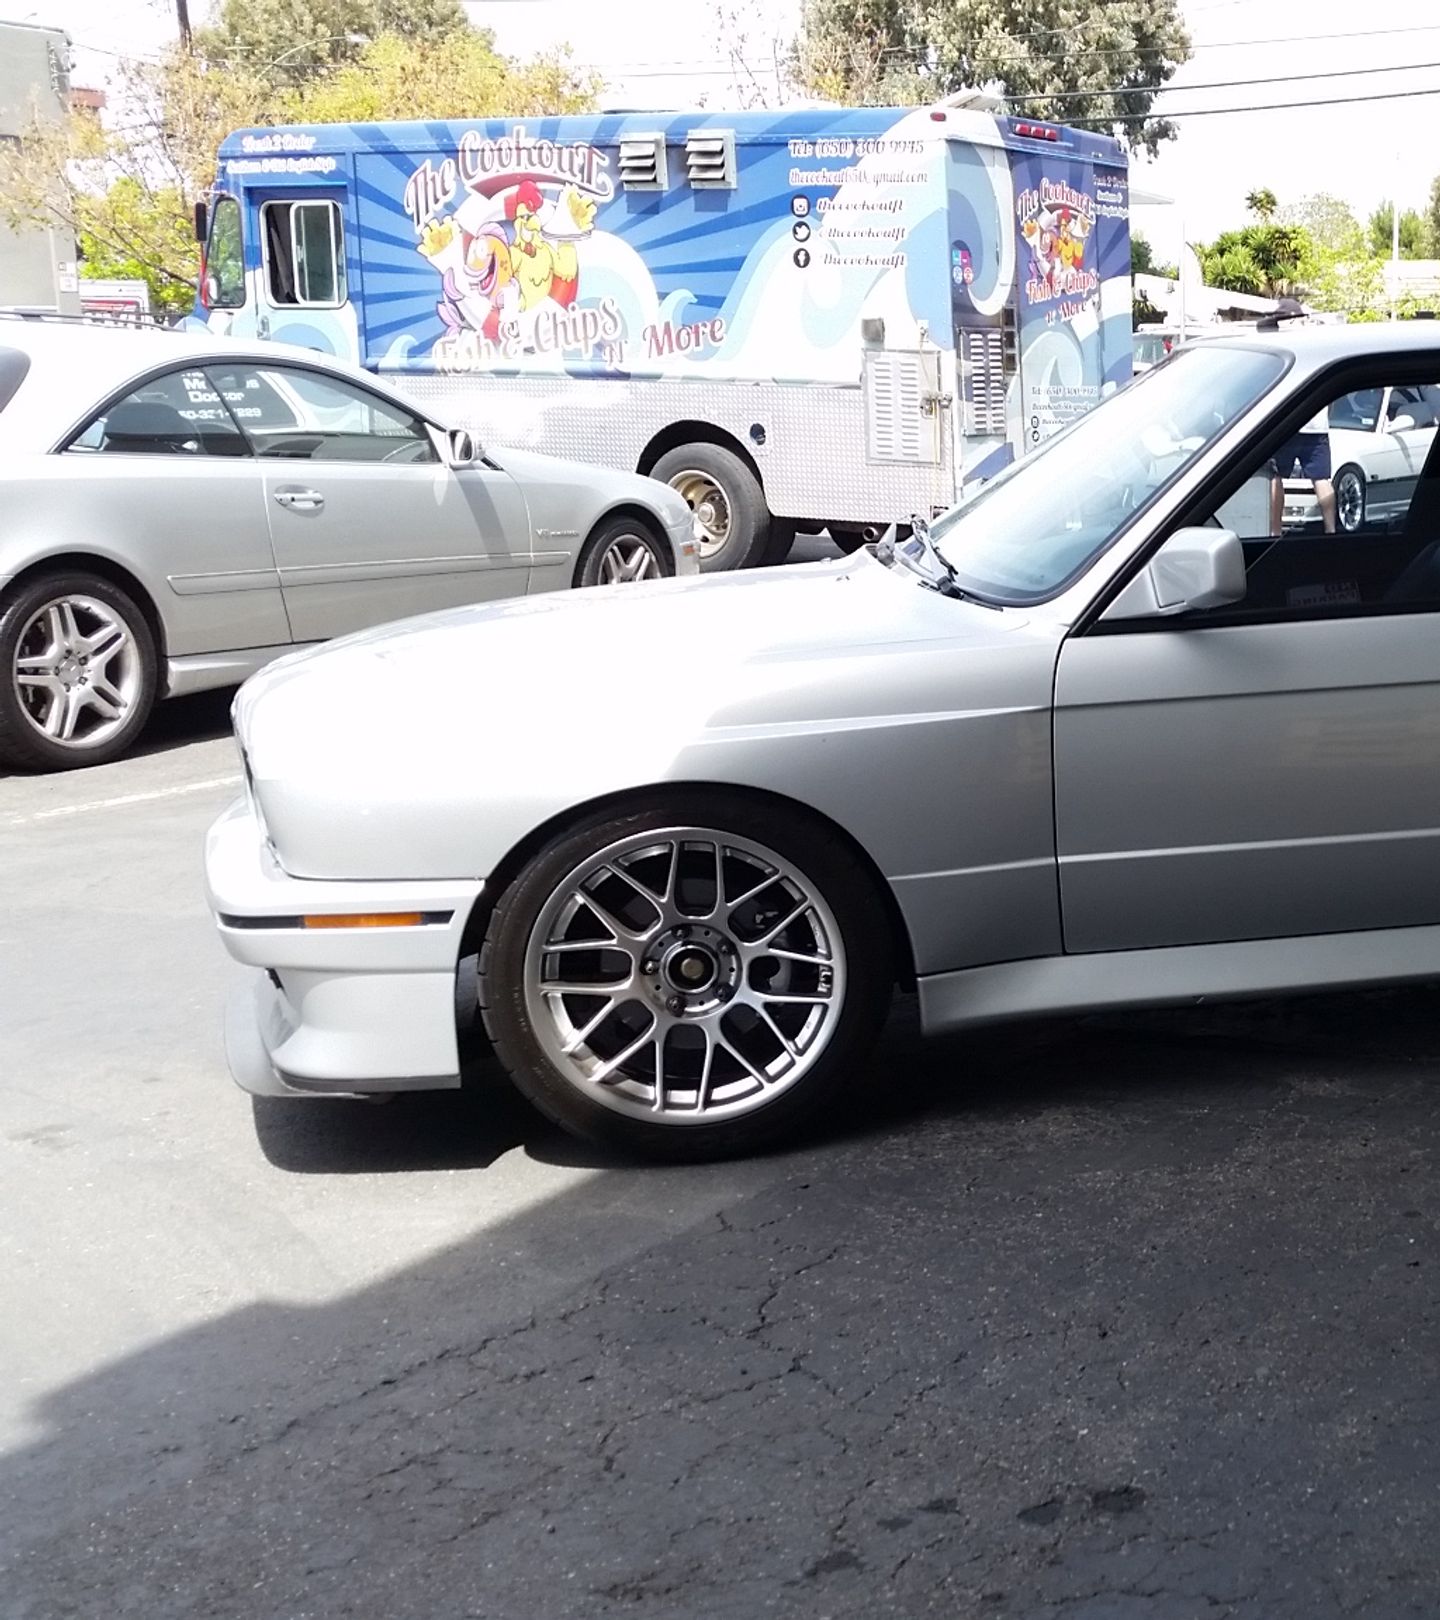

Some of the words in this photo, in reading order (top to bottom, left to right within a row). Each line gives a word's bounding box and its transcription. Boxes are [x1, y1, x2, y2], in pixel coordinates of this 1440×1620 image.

[405, 159, 455, 231] The
[460, 126, 613, 199] Cookout
[1017, 188, 1039, 226] The
[1026, 279, 1052, 305] Fish
[1065, 268, 1097, 298] Chips
[534, 298, 621, 359] Chips
[642, 317, 725, 359] More
